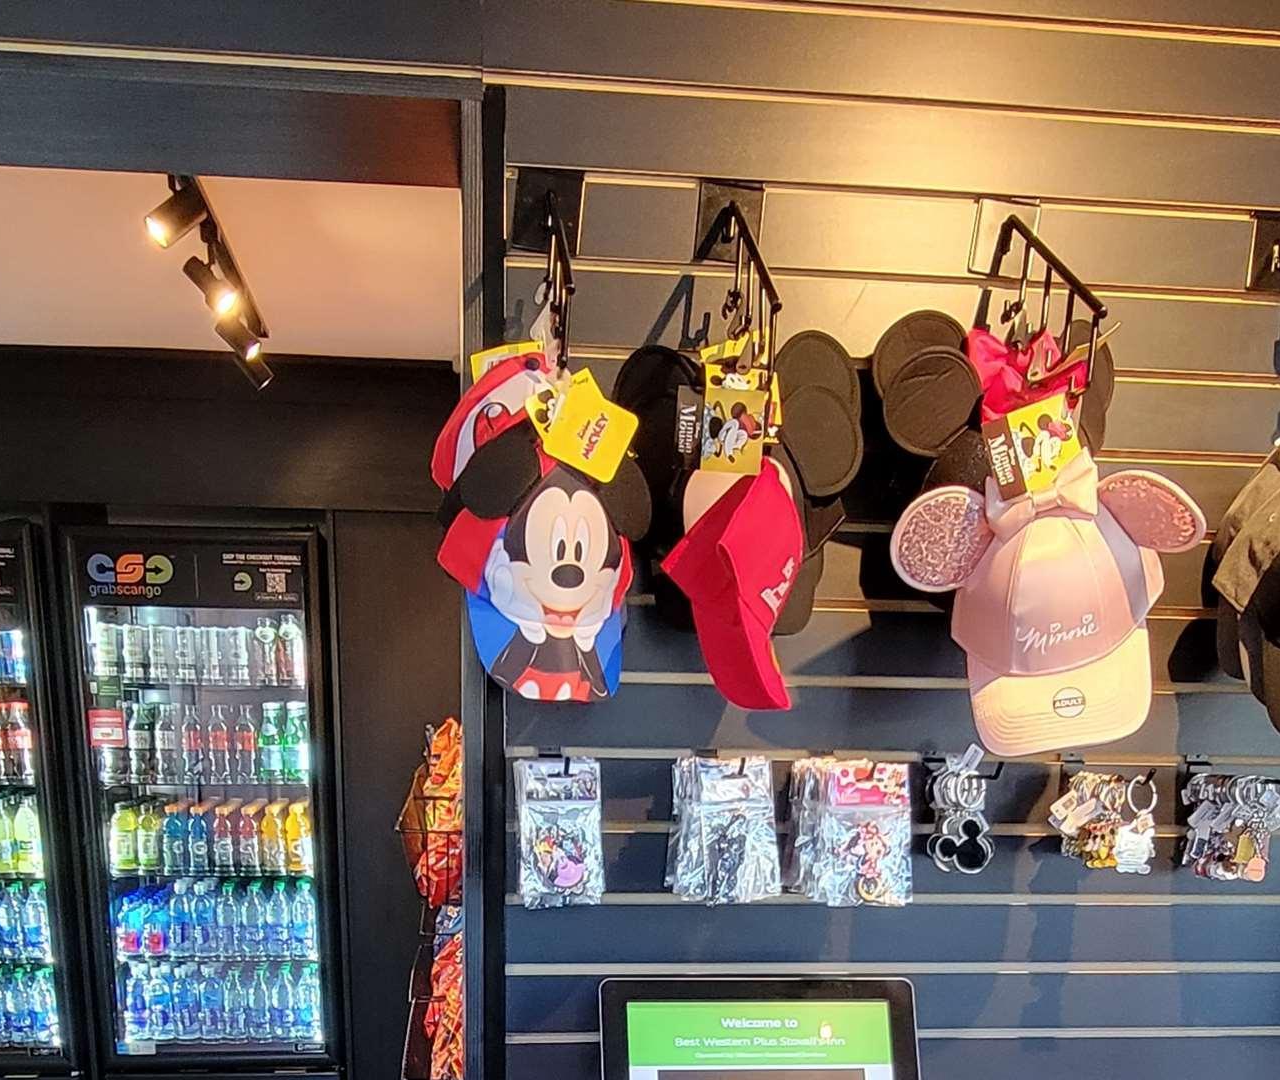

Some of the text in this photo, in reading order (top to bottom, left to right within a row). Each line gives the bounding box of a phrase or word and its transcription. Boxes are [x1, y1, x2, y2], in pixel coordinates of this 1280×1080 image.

[89, 583, 162, 599] grabscango
[1016, 613, 1099, 655] Minnie
[1054, 698, 1083, 709] ADULT
[720, 1017, 798, 1029] Welcome to
[674, 1037, 700, 1047] Best
[703, 1036, 751, 1047] Western
[753, 1036, 778, 1046] Plus
